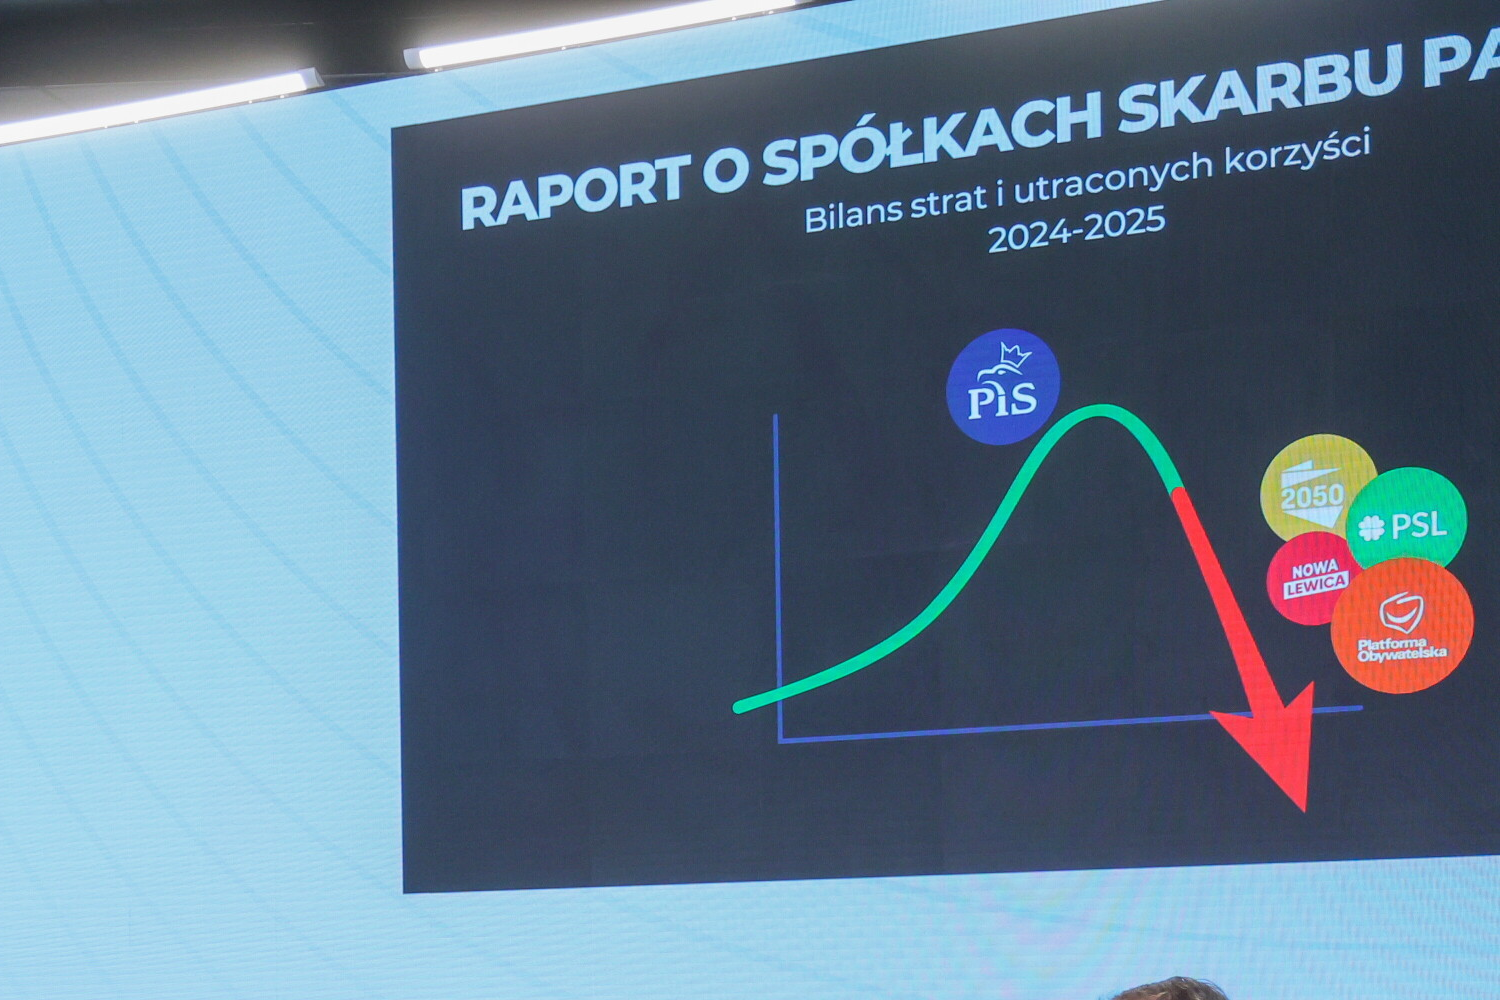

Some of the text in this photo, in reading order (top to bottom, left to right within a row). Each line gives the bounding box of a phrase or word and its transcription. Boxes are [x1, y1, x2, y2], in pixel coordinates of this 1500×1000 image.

[461, 154, 692, 230] RAPORT
[703, 147, 750, 193] O
[762, 91, 1102, 186] SPÓŁKACH
[1118, 43, 1403, 133] SKARBU
[805, 126, 1371, 233] Bilans strat i utraconych korzyści
[988, 205, 1166, 253] 2024-2025
[968, 382, 1037, 420] PiS
[1282, 483, 1344, 508] 2050
[1393, 511, 1447, 539] PSL
[1292, 558, 1339, 579] NOWA
[1287, 573, 1346, 597] LEWICA
[1357, 646, 1448, 663] Obywatelska
[1358, 638, 1427, 651] Platforma
